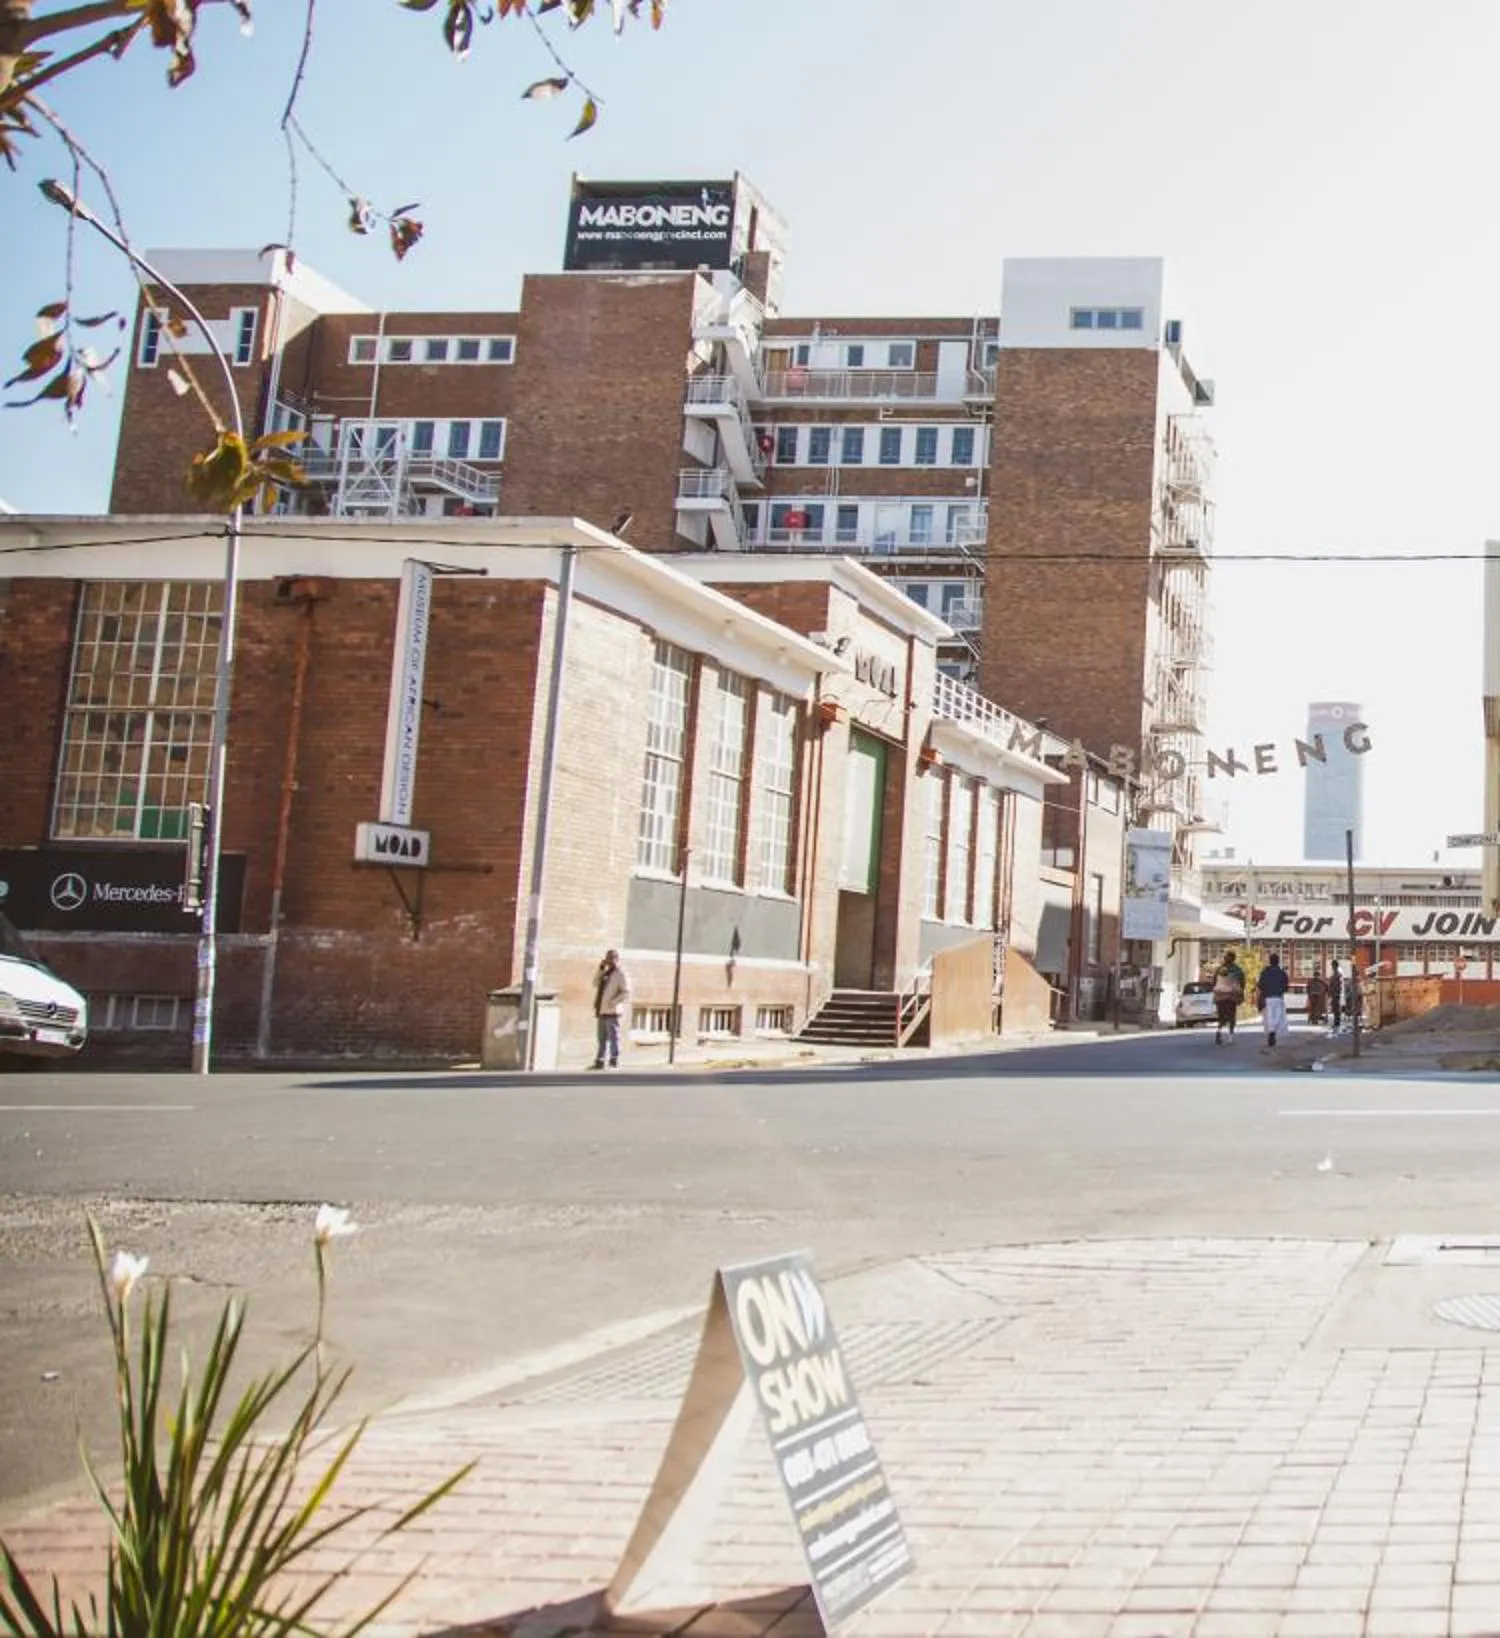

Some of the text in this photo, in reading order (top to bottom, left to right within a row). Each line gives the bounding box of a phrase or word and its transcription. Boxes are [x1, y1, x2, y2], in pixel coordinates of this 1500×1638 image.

[578, 205, 731, 226] MABONENG
[1006, 722, 1374, 780] MABONENG
[375, 831, 421, 858] MOAD
[1273, 910, 1334, 934] For
[1346, 910, 1399, 936] CV
[760, 1348, 847, 1433] SHOW
